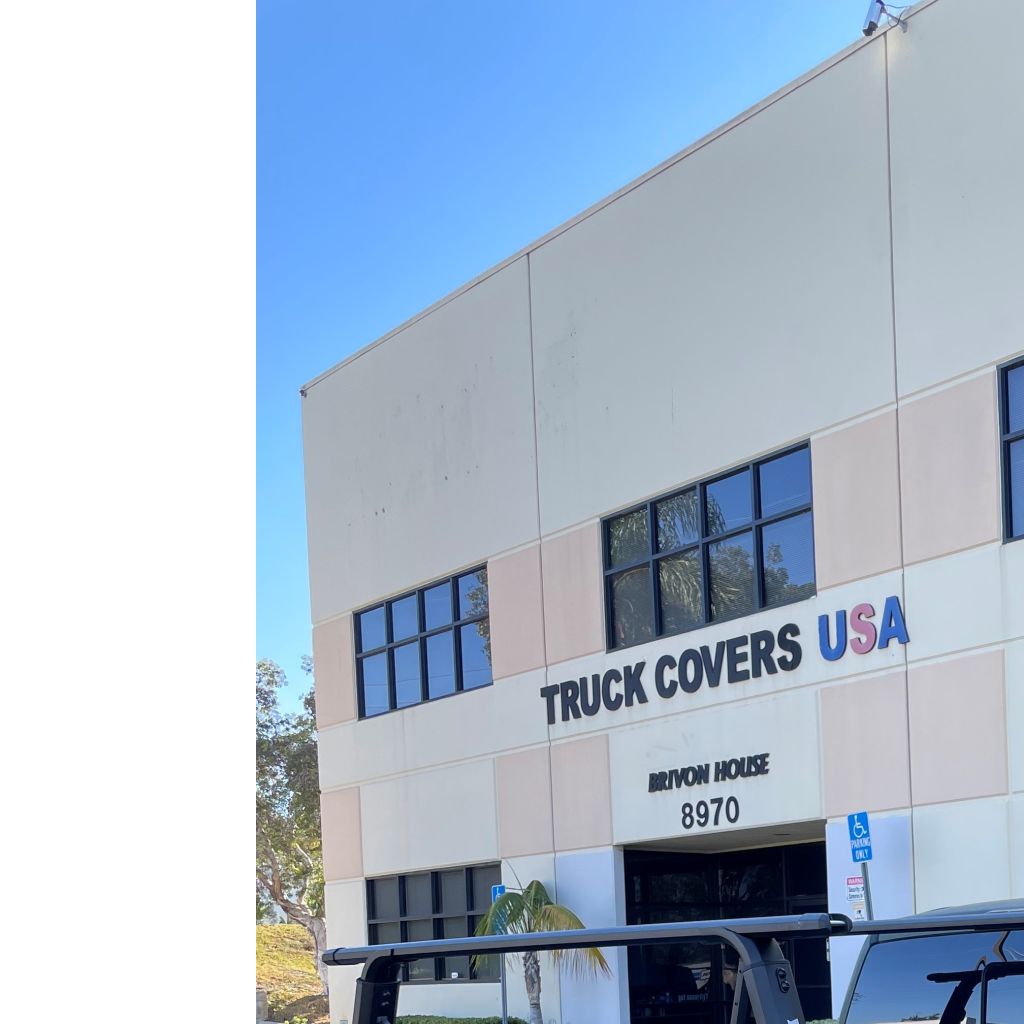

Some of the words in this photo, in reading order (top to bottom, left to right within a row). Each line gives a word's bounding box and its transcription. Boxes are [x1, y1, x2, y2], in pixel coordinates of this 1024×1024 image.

[540, 660, 648, 725] TRUCK
[655, 622, 802, 699] COVERS
[818, 595, 910, 662] USA
[648, 764, 710, 793] BRIVON
[714, 752, 770, 782] HOUSE
[681, 796, 740, 830] 8970
[850, 838, 872, 849] PARKING
[855, 849, 869, 860] ONLY
